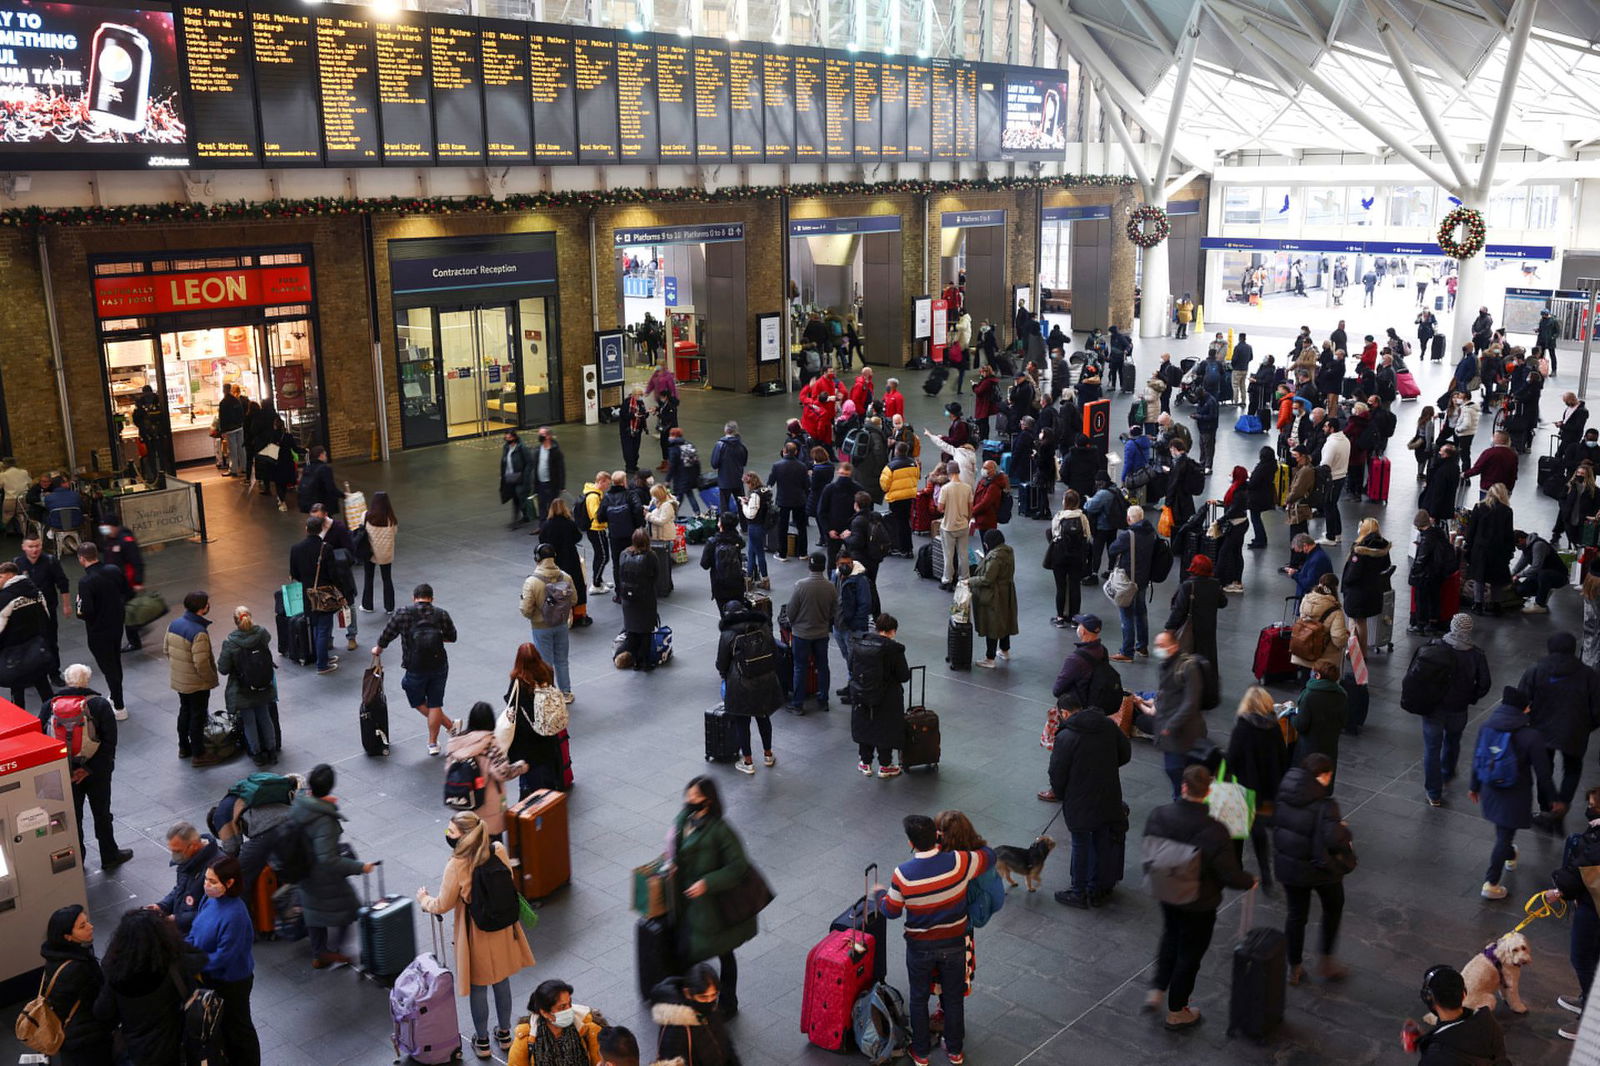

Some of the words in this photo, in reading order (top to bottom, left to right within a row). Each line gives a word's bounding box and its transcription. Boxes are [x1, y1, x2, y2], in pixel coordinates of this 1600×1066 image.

[0, 11, 13, 27] Y
[17, 12, 42, 29] TO
[31, 68, 82, 85] TASTE
[633, 232, 661, 242] Platforms
[684, 230, 709, 238] Platforms
[432, 266, 479, 278] Contractors'
[480, 264, 517, 275] Reception
[170, 275, 247, 306] LEON
[102, 297, 123, 306] FAST
[128, 296, 154, 304] FOOD
[132, 520, 153, 531] FAST
[156, 515, 183, 526] FOOD
